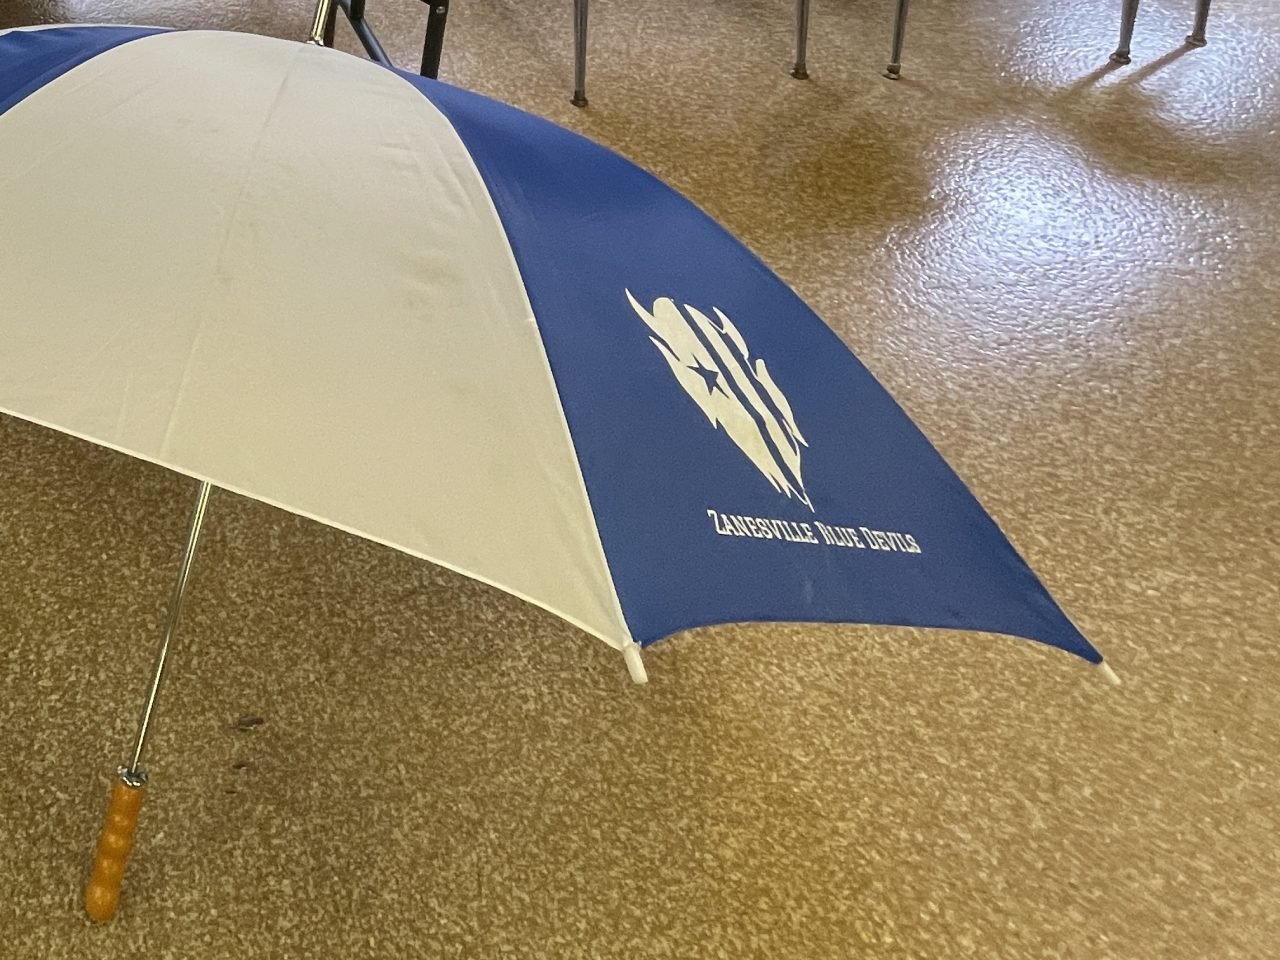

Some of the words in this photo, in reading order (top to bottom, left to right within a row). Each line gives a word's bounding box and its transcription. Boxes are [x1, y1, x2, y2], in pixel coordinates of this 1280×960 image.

[706, 509, 819, 545] ZANESVILLE
[814, 521, 866, 549] BLUE
[859, 526, 923, 554] DEVILS
